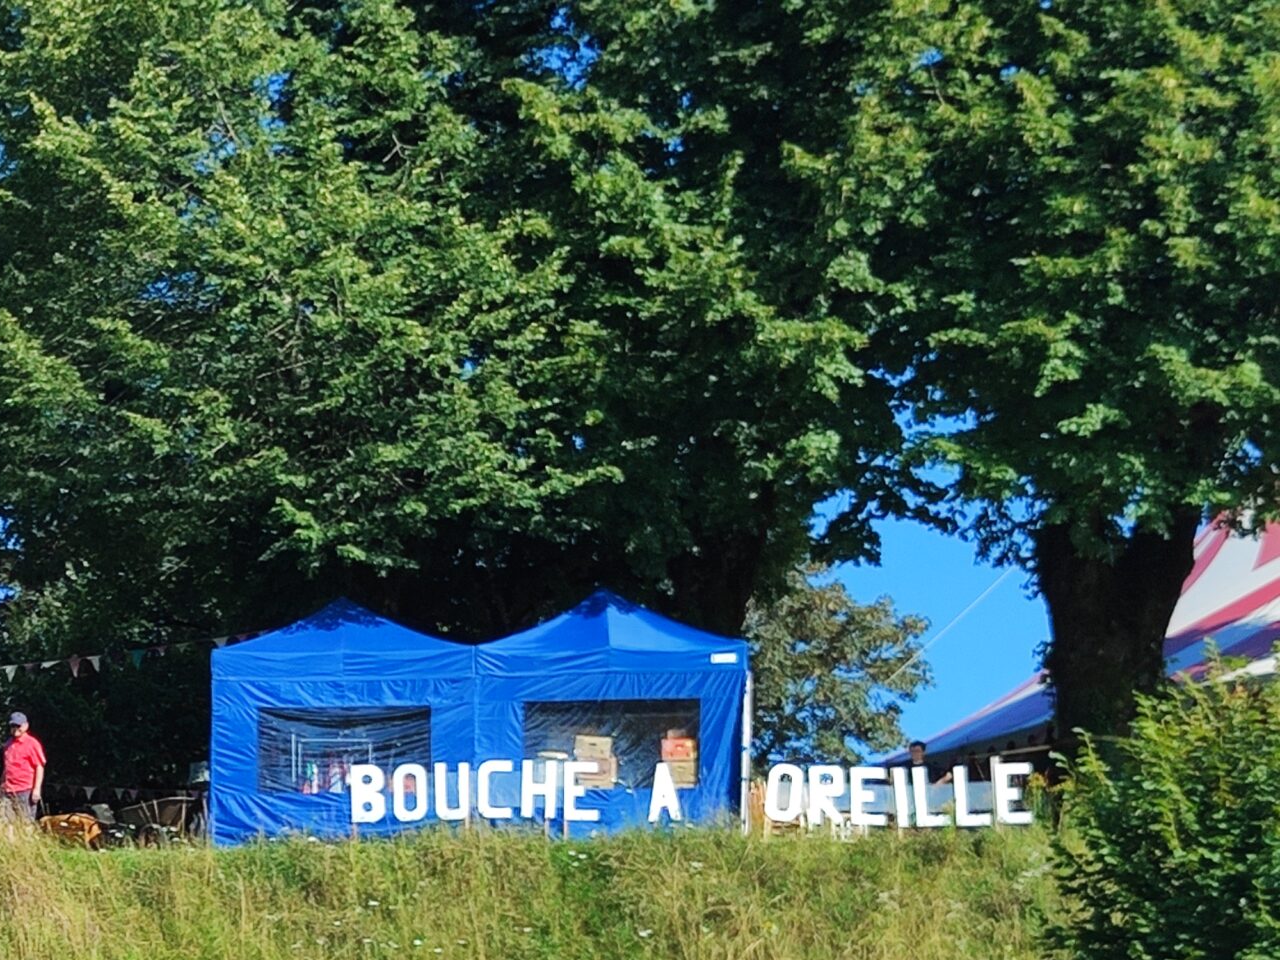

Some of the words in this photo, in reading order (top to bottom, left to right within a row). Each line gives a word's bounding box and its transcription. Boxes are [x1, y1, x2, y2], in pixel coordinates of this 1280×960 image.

[349, 759, 600, 823] BOUCHE
[647, 761, 683, 823] A
[764, 761, 1034, 828] OREILLE
